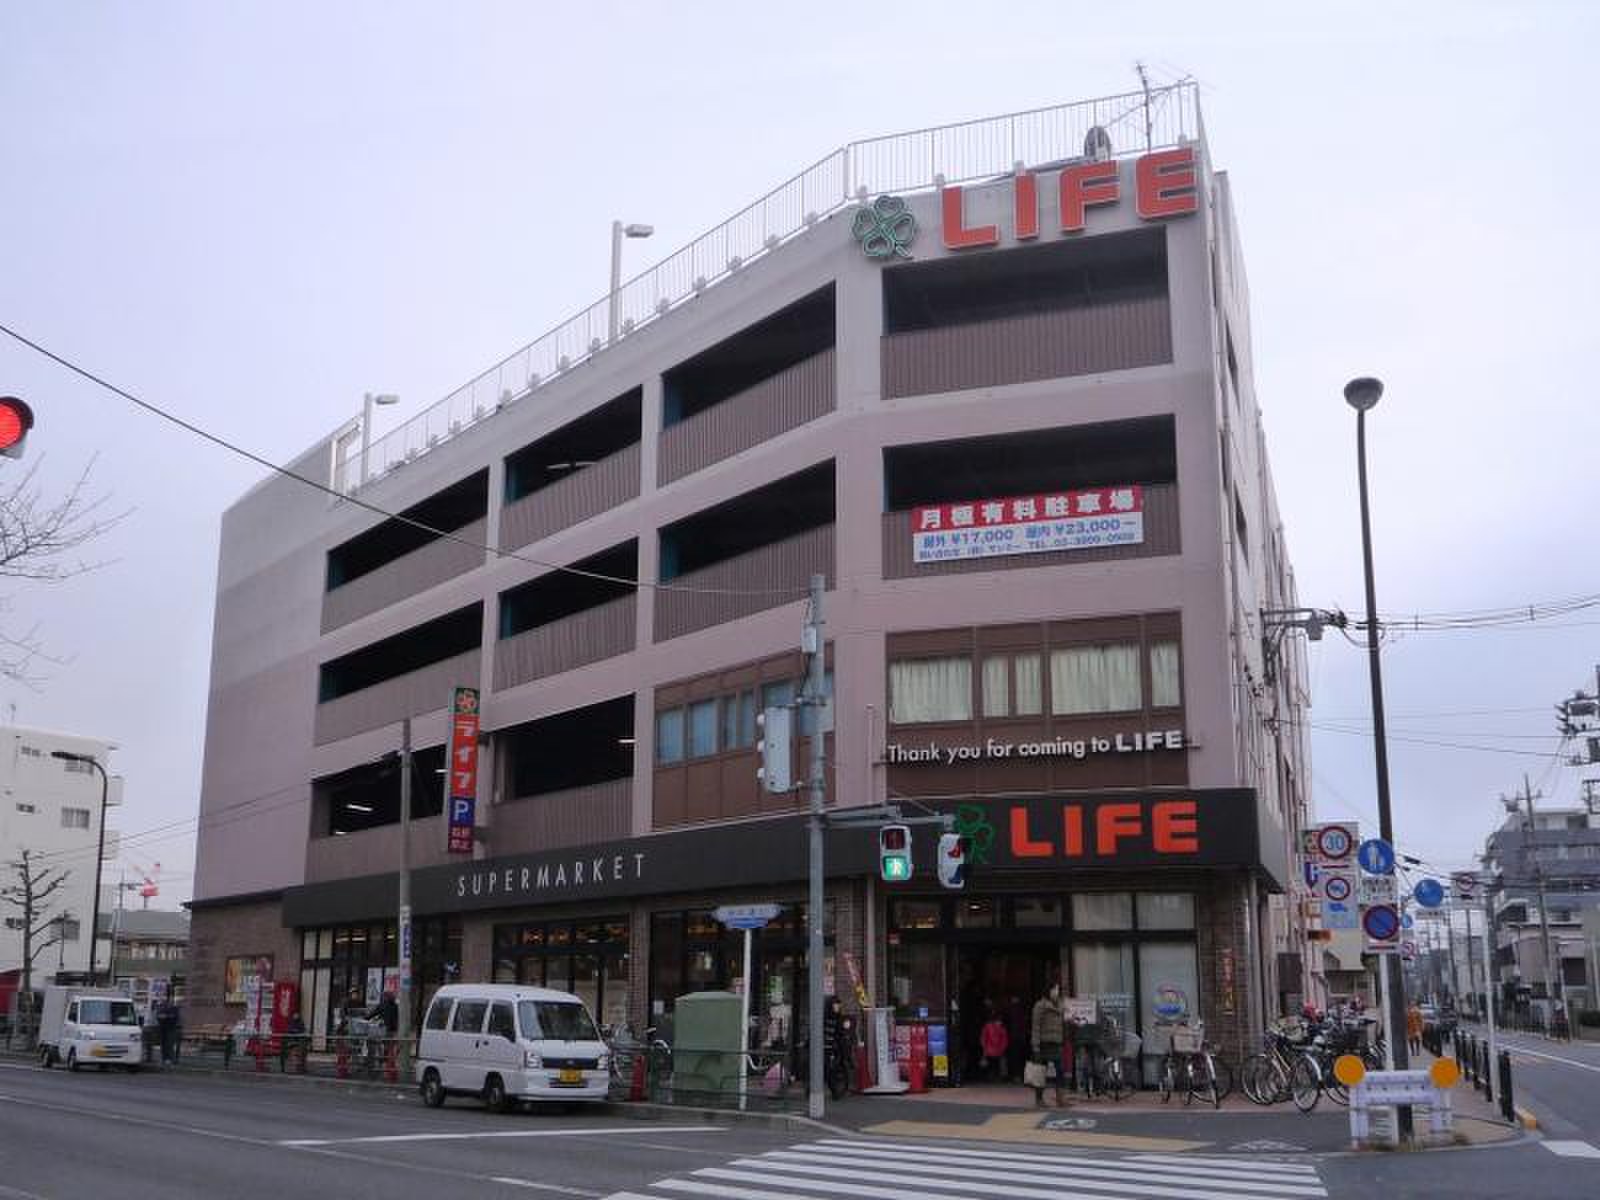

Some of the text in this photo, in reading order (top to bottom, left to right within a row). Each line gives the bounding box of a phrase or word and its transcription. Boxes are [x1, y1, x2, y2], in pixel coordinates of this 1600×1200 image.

[941, 146, 1199, 250] LIFE
[454, 721, 476, 789] ライフ
[887, 729, 1183, 765] Thank you for coming to LIFE
[453, 799, 469, 821] P
[1009, 800, 1200, 857] LIFE
[1325, 834, 1344, 850] 30
[457, 853, 645, 897] SUPERMARKET
